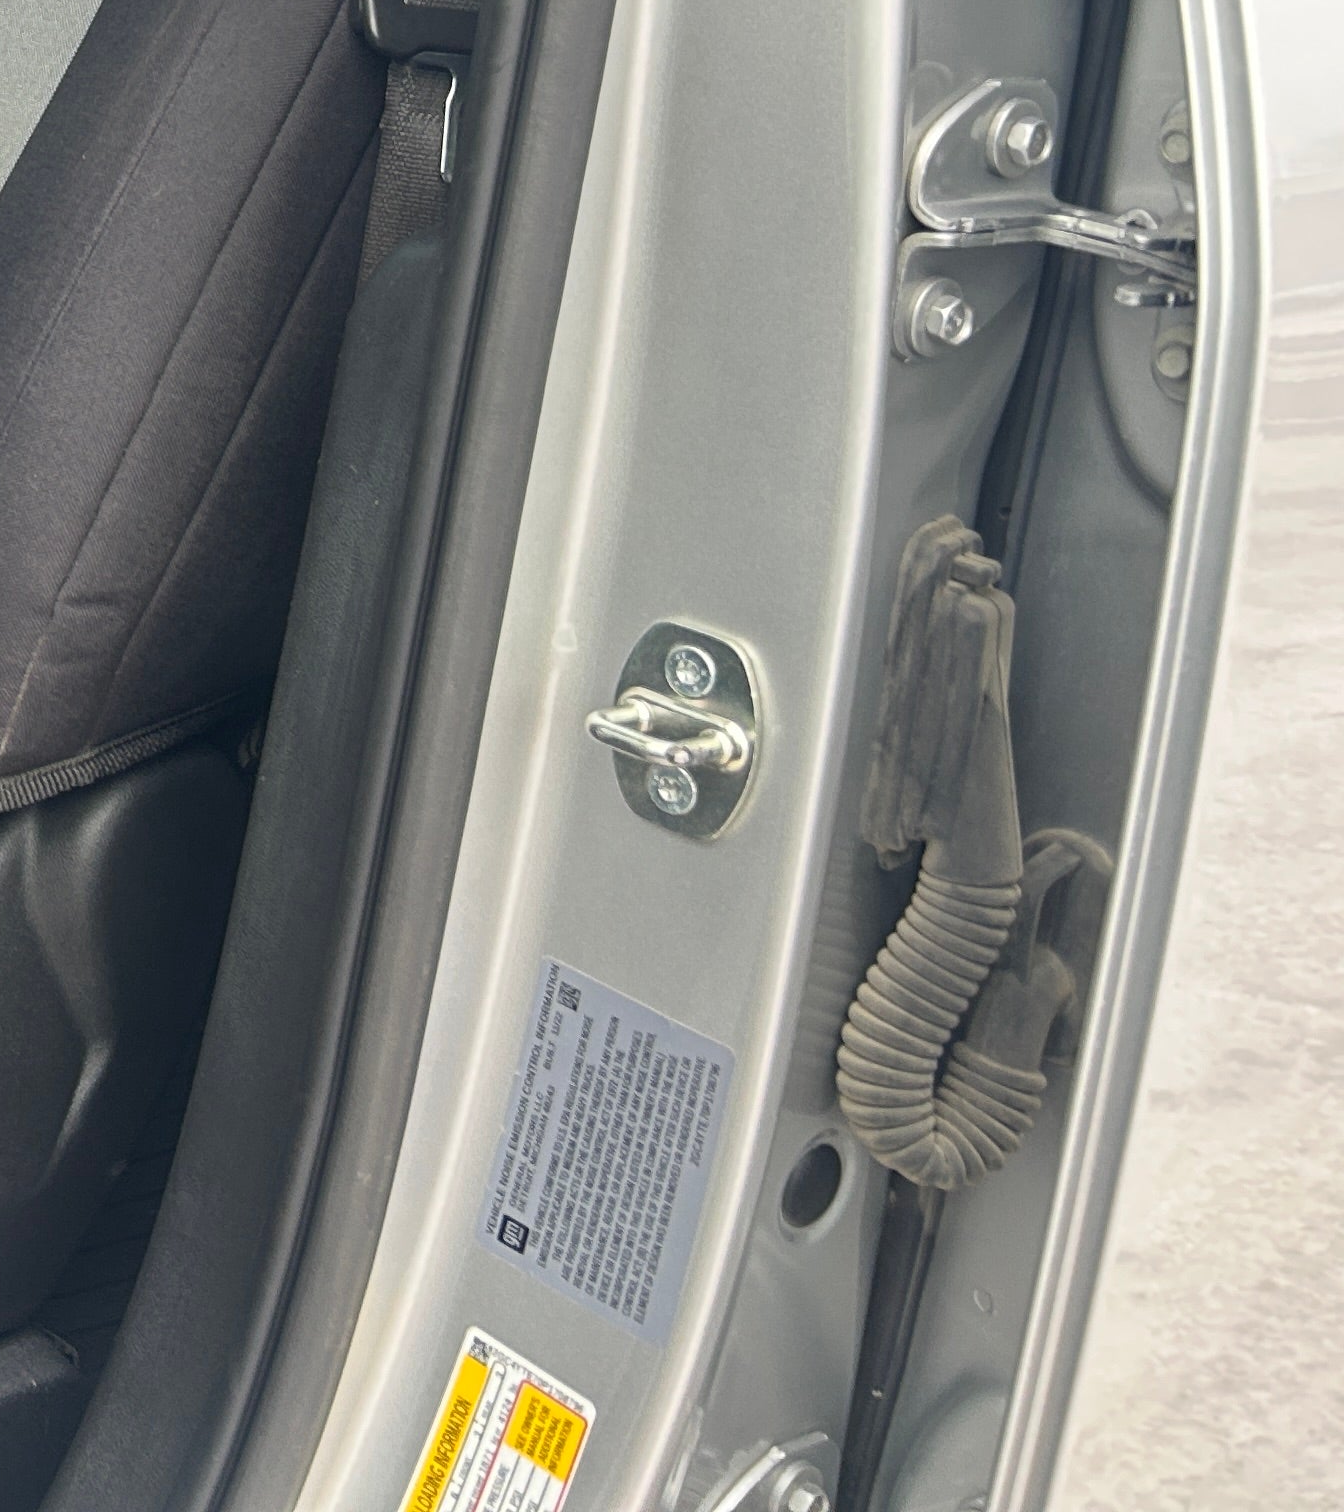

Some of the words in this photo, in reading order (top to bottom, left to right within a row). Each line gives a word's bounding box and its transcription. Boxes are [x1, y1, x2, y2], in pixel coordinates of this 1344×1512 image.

[486, 1188, 505, 1236] VEHICLE
[498, 1151, 514, 1186] NOISE
[507, 1095, 528, 1150] EMISSION
[521, 1041, 541, 1095] CONTROL
[534, 963, 560, 1040] INFORMATION
[509, 1160, 526, 1208] GENERAL
[522, 1113, 538, 1157] MOTORS
[533, 1091, 543, 1112] LLC
[543, 1040, 556, 1070] BUILT
[501, 1217, 526, 1251] gm
[413, 1464, 445, 1512] LOADING
[433, 1395, 472, 1469] INFORMATION
[526, 1423, 546, 1458] MANUAL
[538, 1404, 551, 1424] FOR
[537, 1417, 561, 1465] ADDITIONAL
[548, 1418, 574, 1474] INFORMATION
[486, 1463, 510, 1507] PRESSURE
